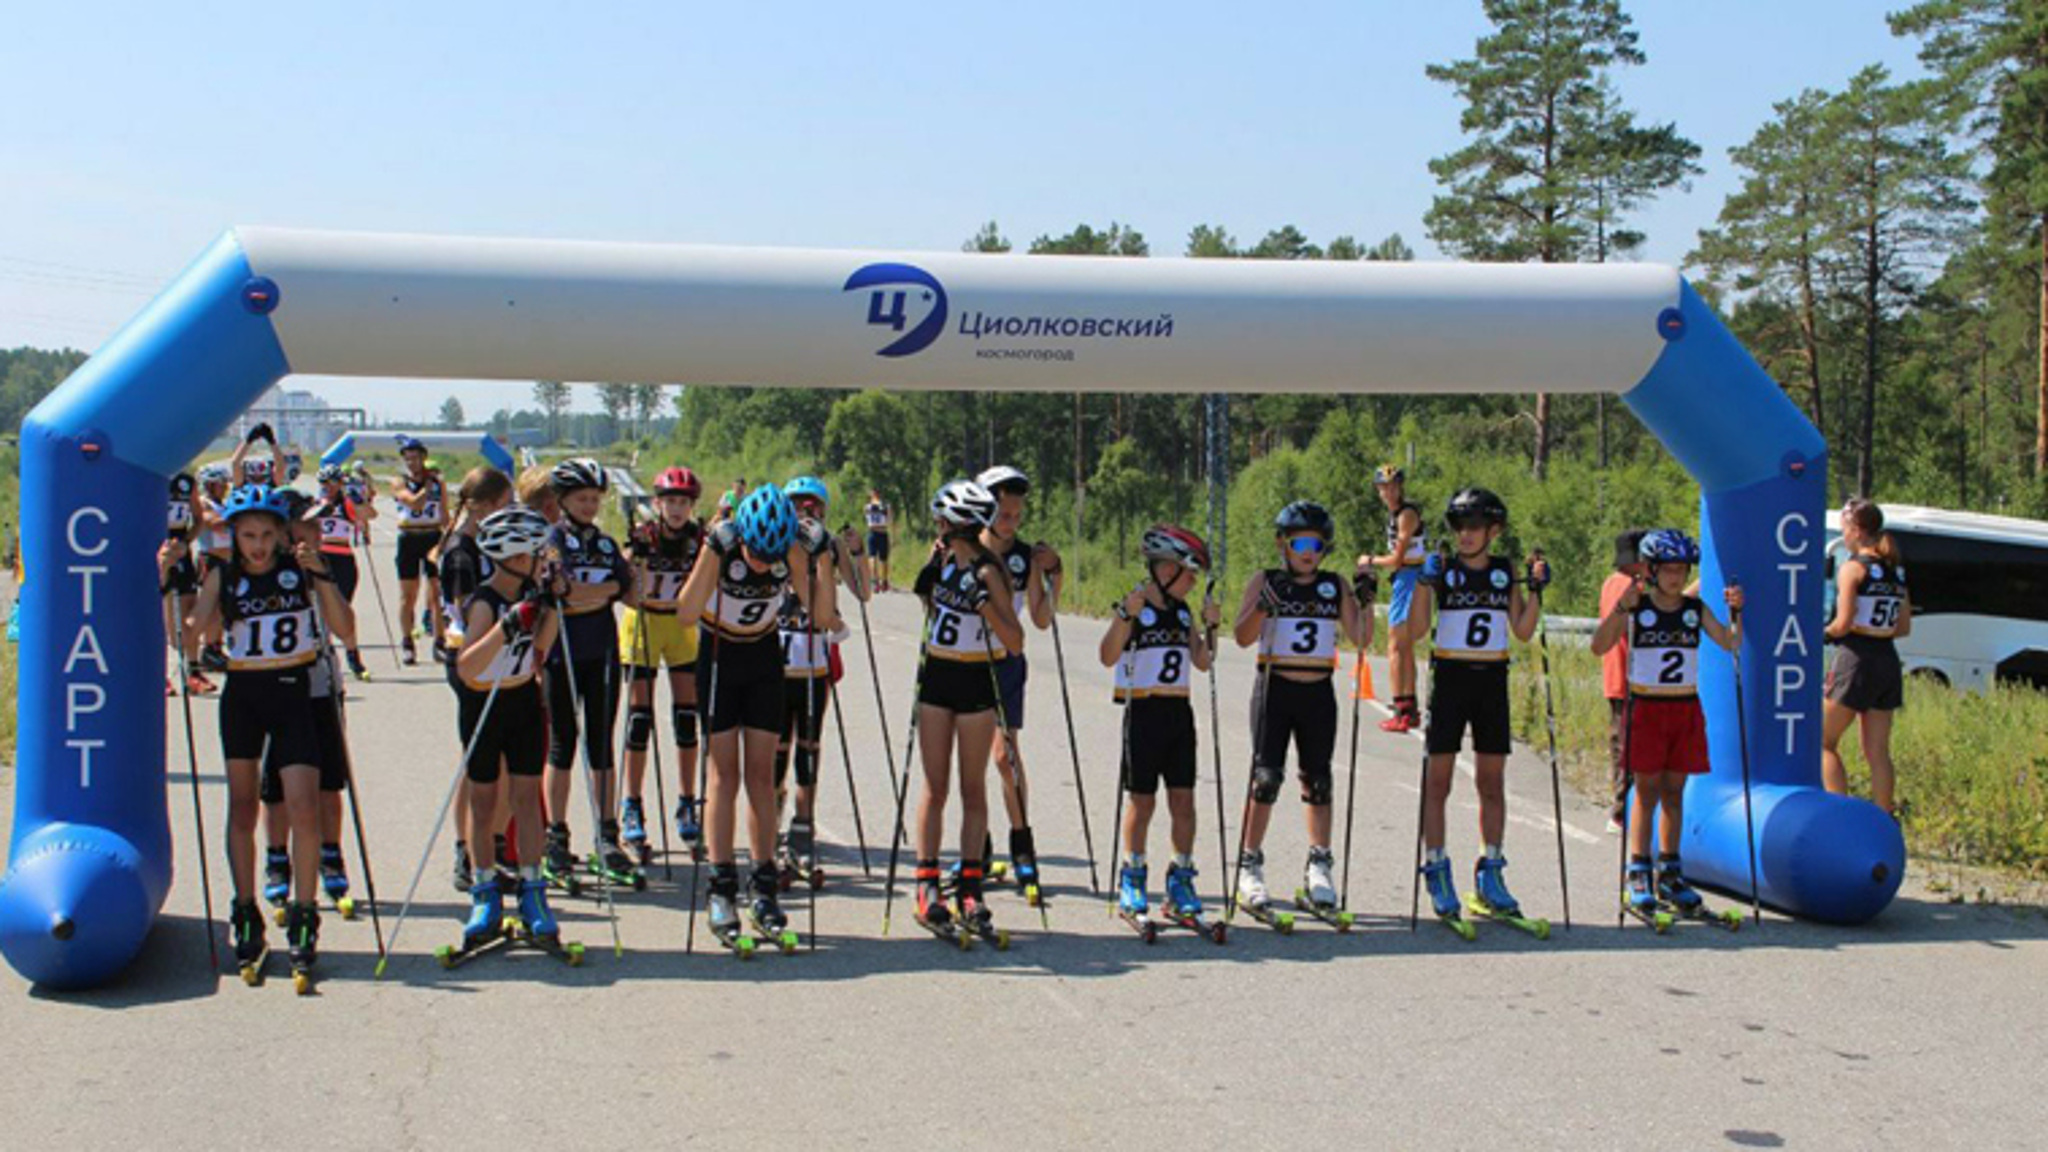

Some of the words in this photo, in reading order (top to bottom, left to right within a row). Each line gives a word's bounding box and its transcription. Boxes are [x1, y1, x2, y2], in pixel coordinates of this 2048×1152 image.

[959, 312, 1174, 337] Циолковский
[975, 350, 1075, 361] космогород
[738, 602, 769, 625] 9
[1465, 611, 1492, 648] 6
[64, 507, 108, 786] СТАРТ
[245, 615, 299, 656] 18
[1291, 620, 1319, 654] 3
[1774, 513, 1808, 754] СТАРТ
[1157, 648, 1184, 684] 8
[1658, 650, 1685, 684] 2
